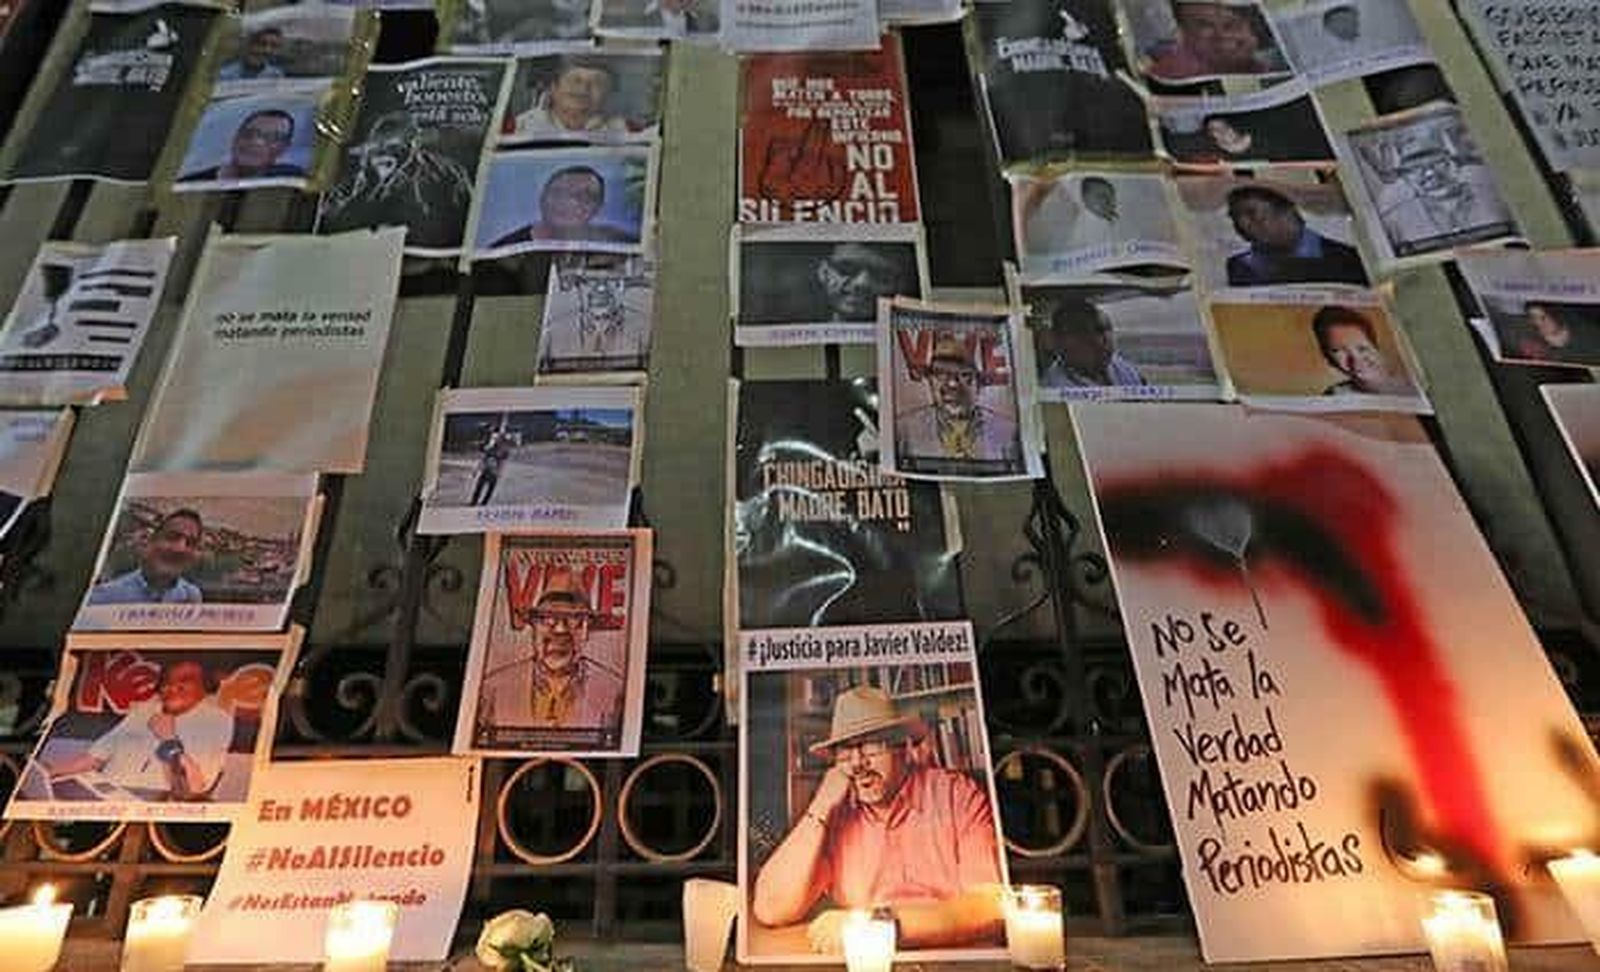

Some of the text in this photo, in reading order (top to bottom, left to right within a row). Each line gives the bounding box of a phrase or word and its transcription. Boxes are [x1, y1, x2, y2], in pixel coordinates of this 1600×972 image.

[847, 144, 893, 171] NO
[851, 172, 898, 200] AL
[826, 637, 860, 663] para
[863, 631, 908, 658] Javier
[911, 628, 969, 655] Valdez!
[1164, 650, 1281, 719] Mata la
[1173, 706, 1283, 765] Verdad
[258, 792, 413, 822] En MÉXICO
[1188, 760, 1317, 840] Matando
[1197, 822, 1364, 893] Periodistas
[228, 888, 428, 911] #NosEstanMtando
